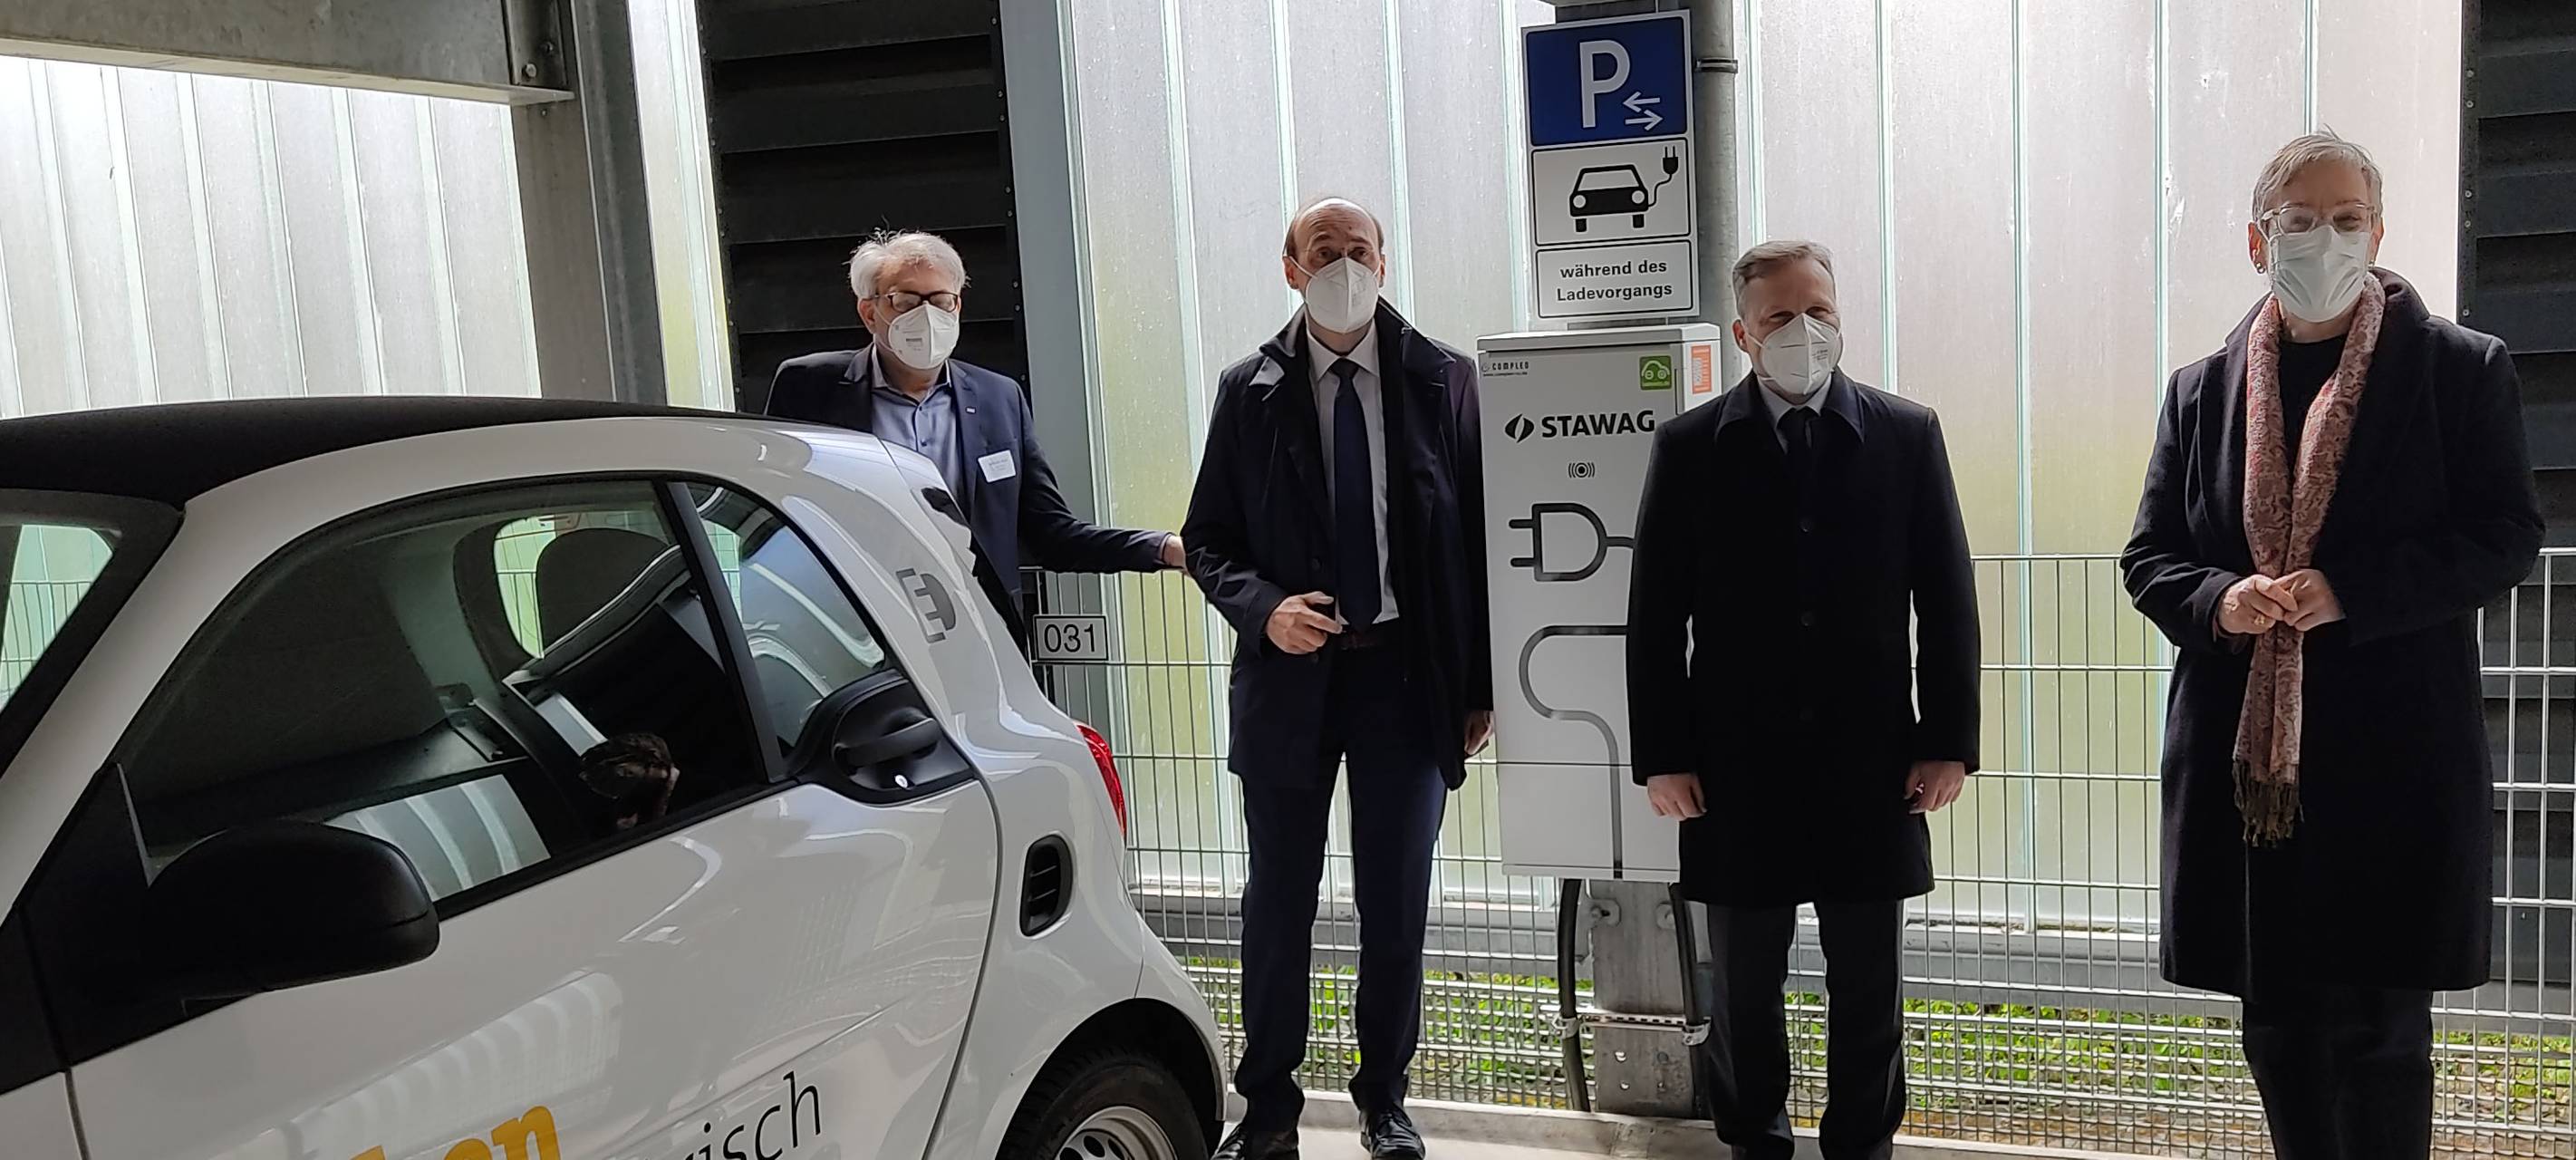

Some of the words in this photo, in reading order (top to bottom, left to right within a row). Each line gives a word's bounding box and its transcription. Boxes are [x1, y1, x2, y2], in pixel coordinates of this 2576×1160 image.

[1579, 39, 1631, 129] P
[1559, 260, 1632, 277] während
[1637, 259, 1667, 274] des
[1557, 285, 1673, 302] Ladevorgangs
[1491, 361, 1529, 371] COMPLEO
[1542, 410, 1655, 439] STAWAG
[1044, 624, 1095, 653] 031
